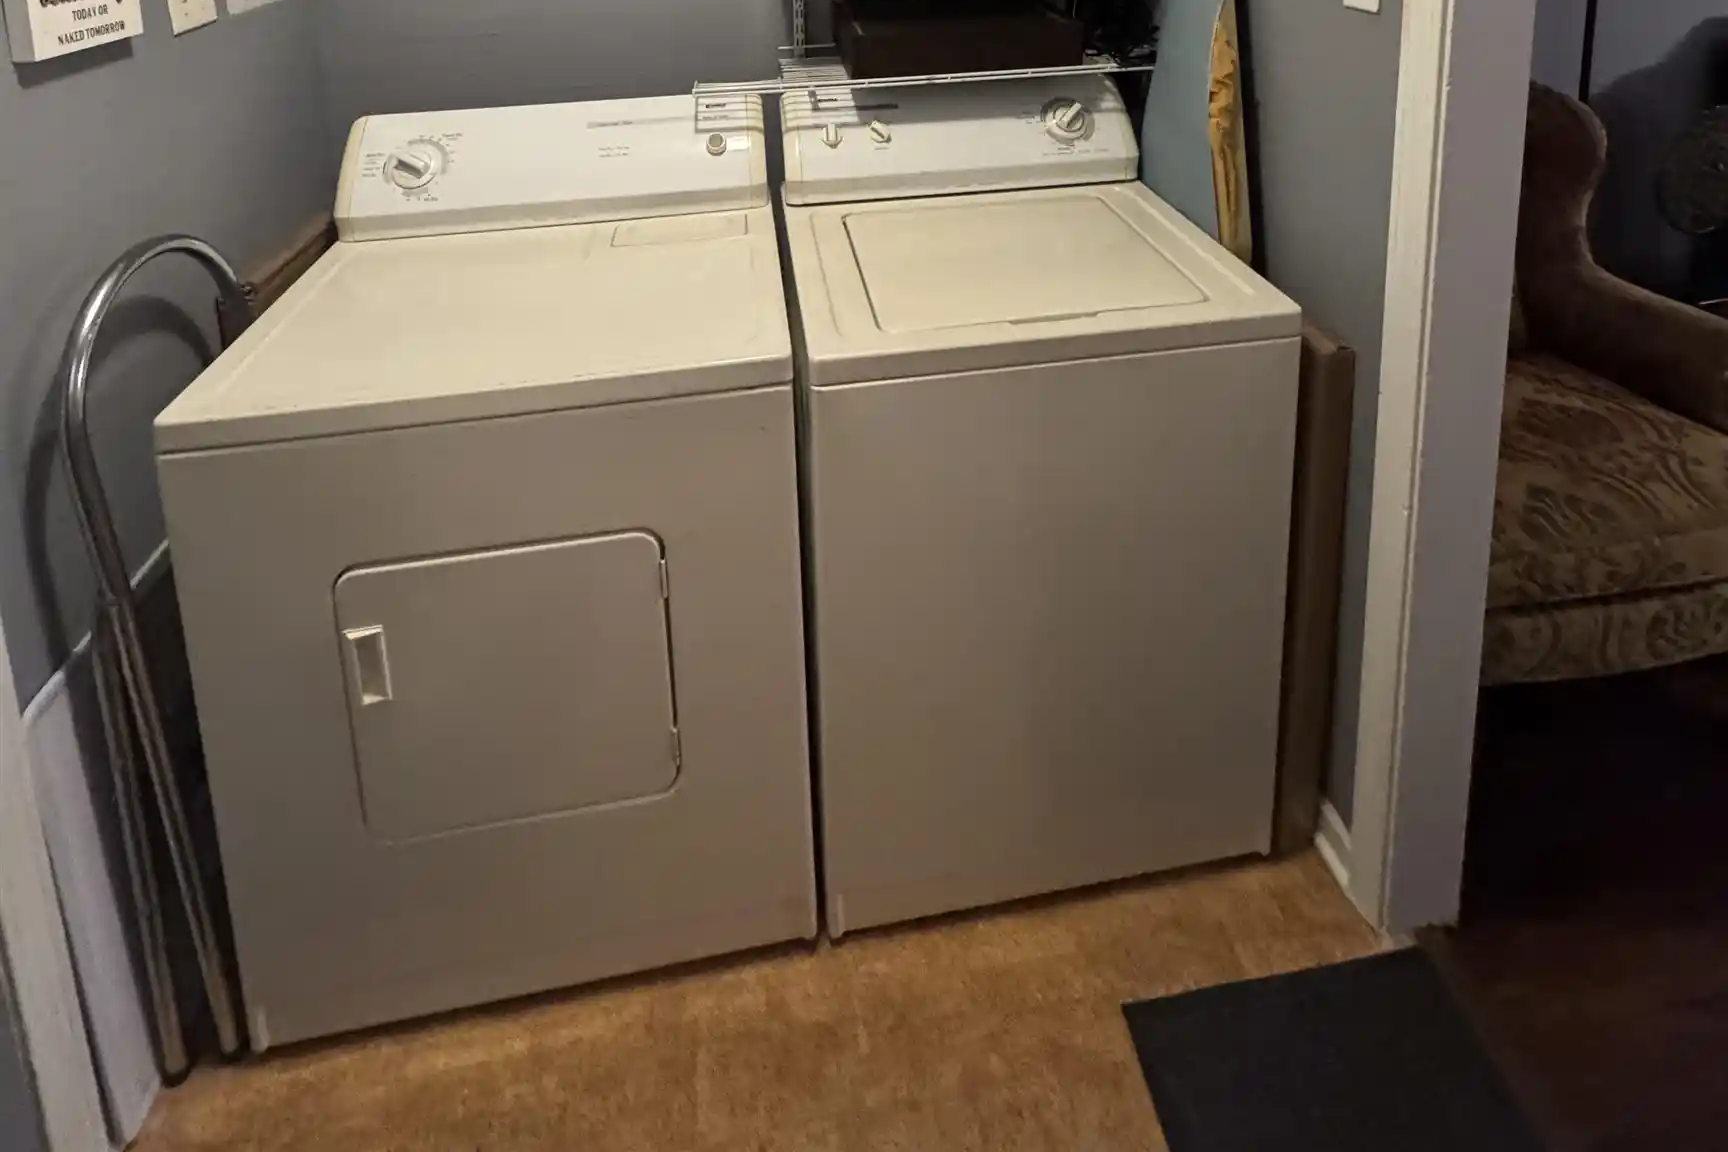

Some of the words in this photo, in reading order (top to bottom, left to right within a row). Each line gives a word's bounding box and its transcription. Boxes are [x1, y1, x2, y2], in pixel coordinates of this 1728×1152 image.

[72, 6, 96, 22] TODAY
[98, 4, 109, 16] OR
[58, 28, 85, 46] NAKED
[85, 20, 125, 39] TOMORROW
